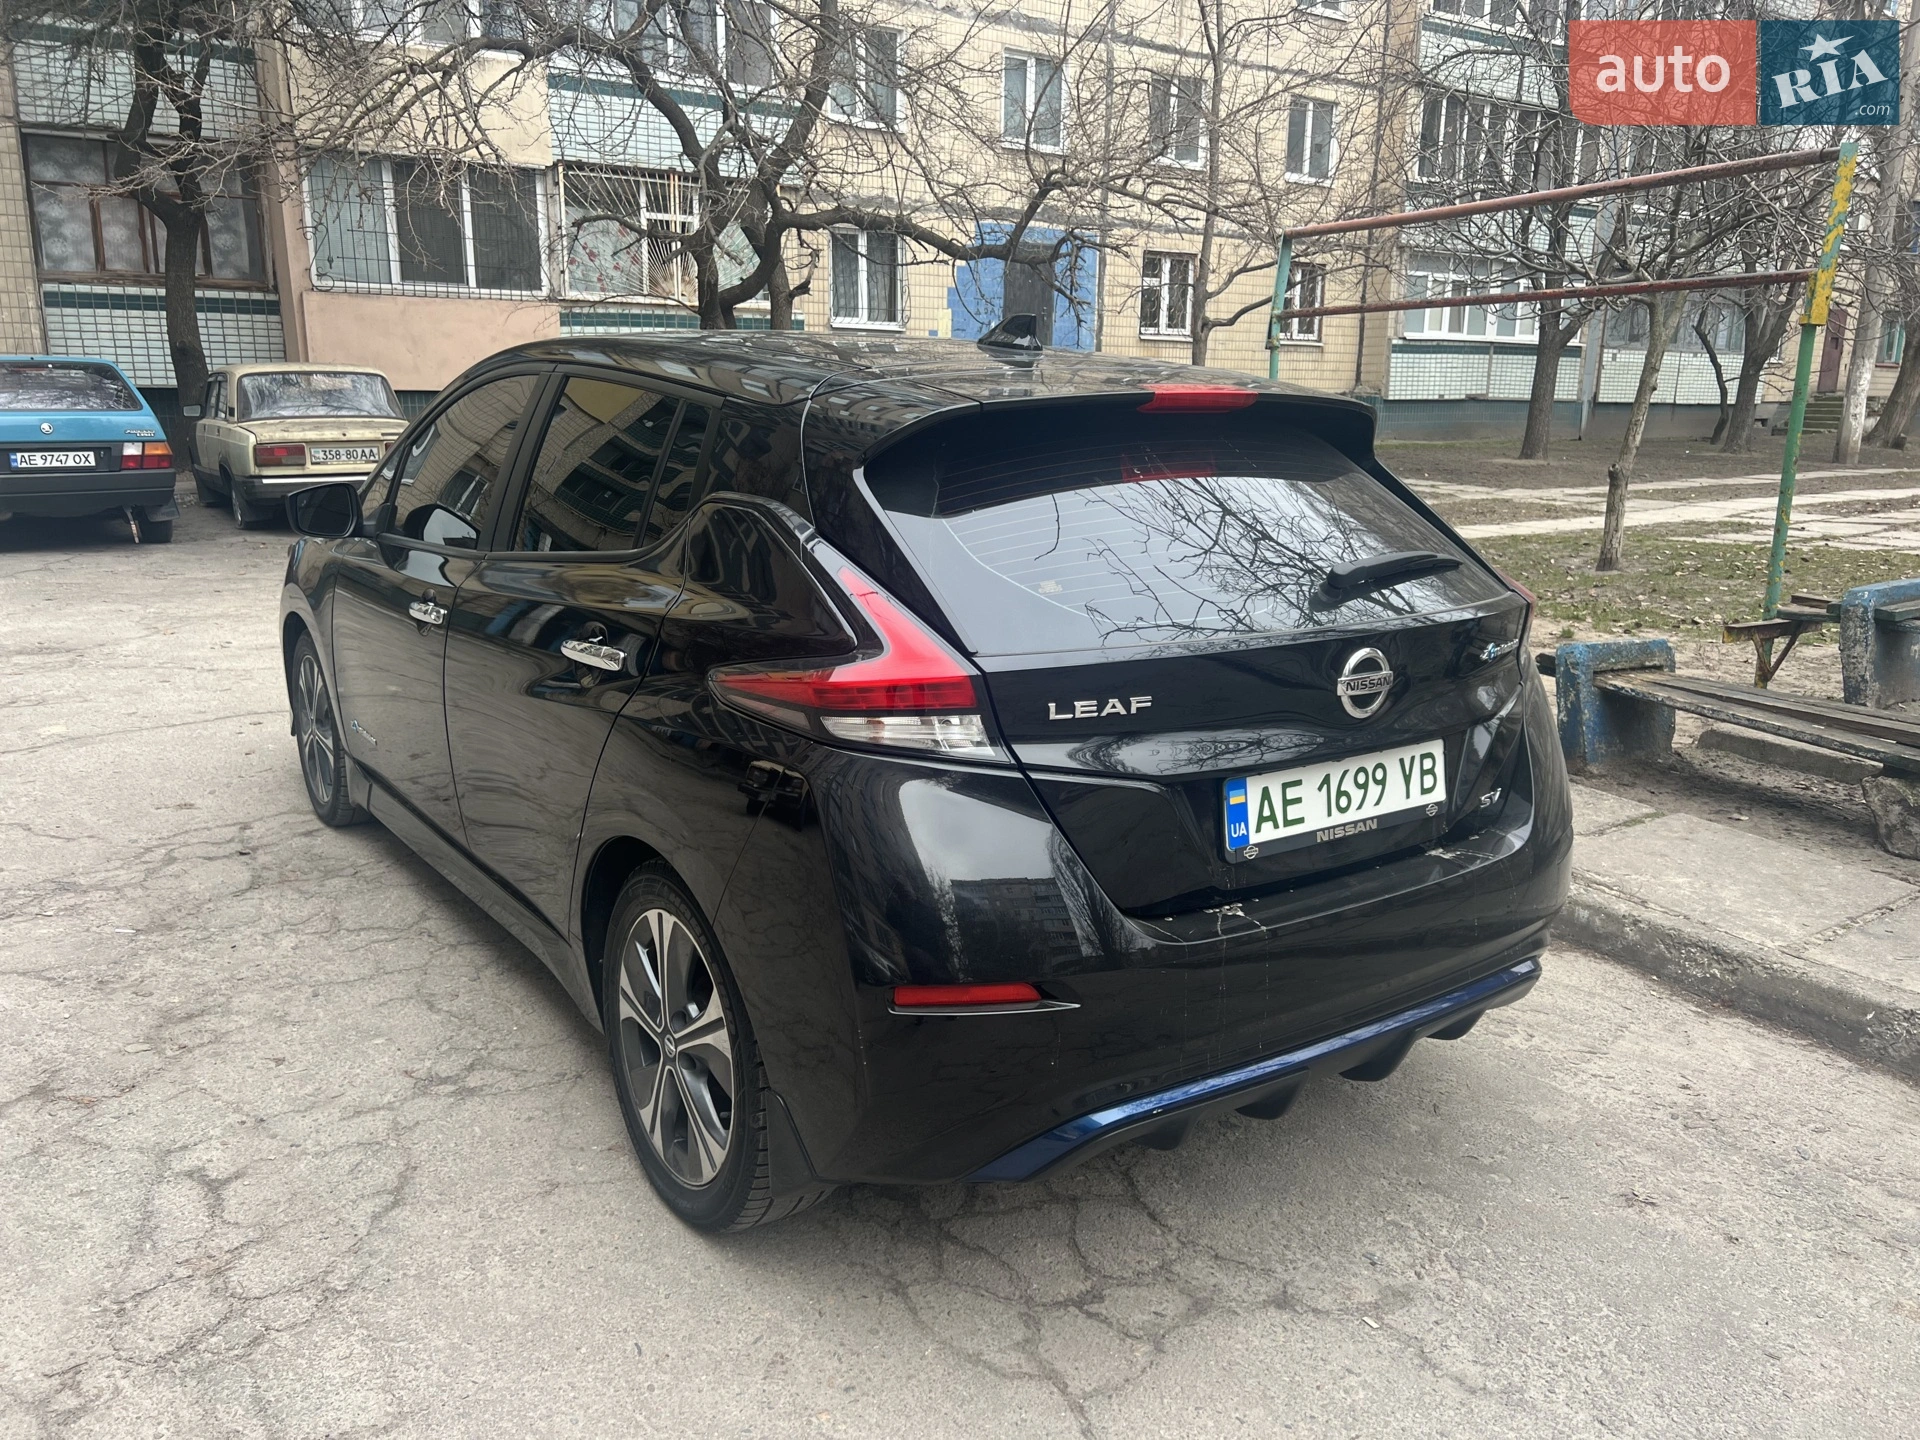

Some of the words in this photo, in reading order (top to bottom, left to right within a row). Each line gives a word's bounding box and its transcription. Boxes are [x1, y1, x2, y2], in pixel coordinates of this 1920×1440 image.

[19, 454, 38, 466] AE
[40, 454, 69, 465] 9747
[72, 453, 92, 465] OX
[1345, 676, 1391, 692] NISSAN
[1047, 695, 1153, 720] LEAF
[1254, 778, 1305, 834] AE
[1317, 762, 1388, 818] 1699
[1398, 751, 1438, 800] YB
[1479, 787, 1502, 808] SV
[1231, 821, 1247, 838] UA
[1317, 818, 1378, 843] NISSAN
